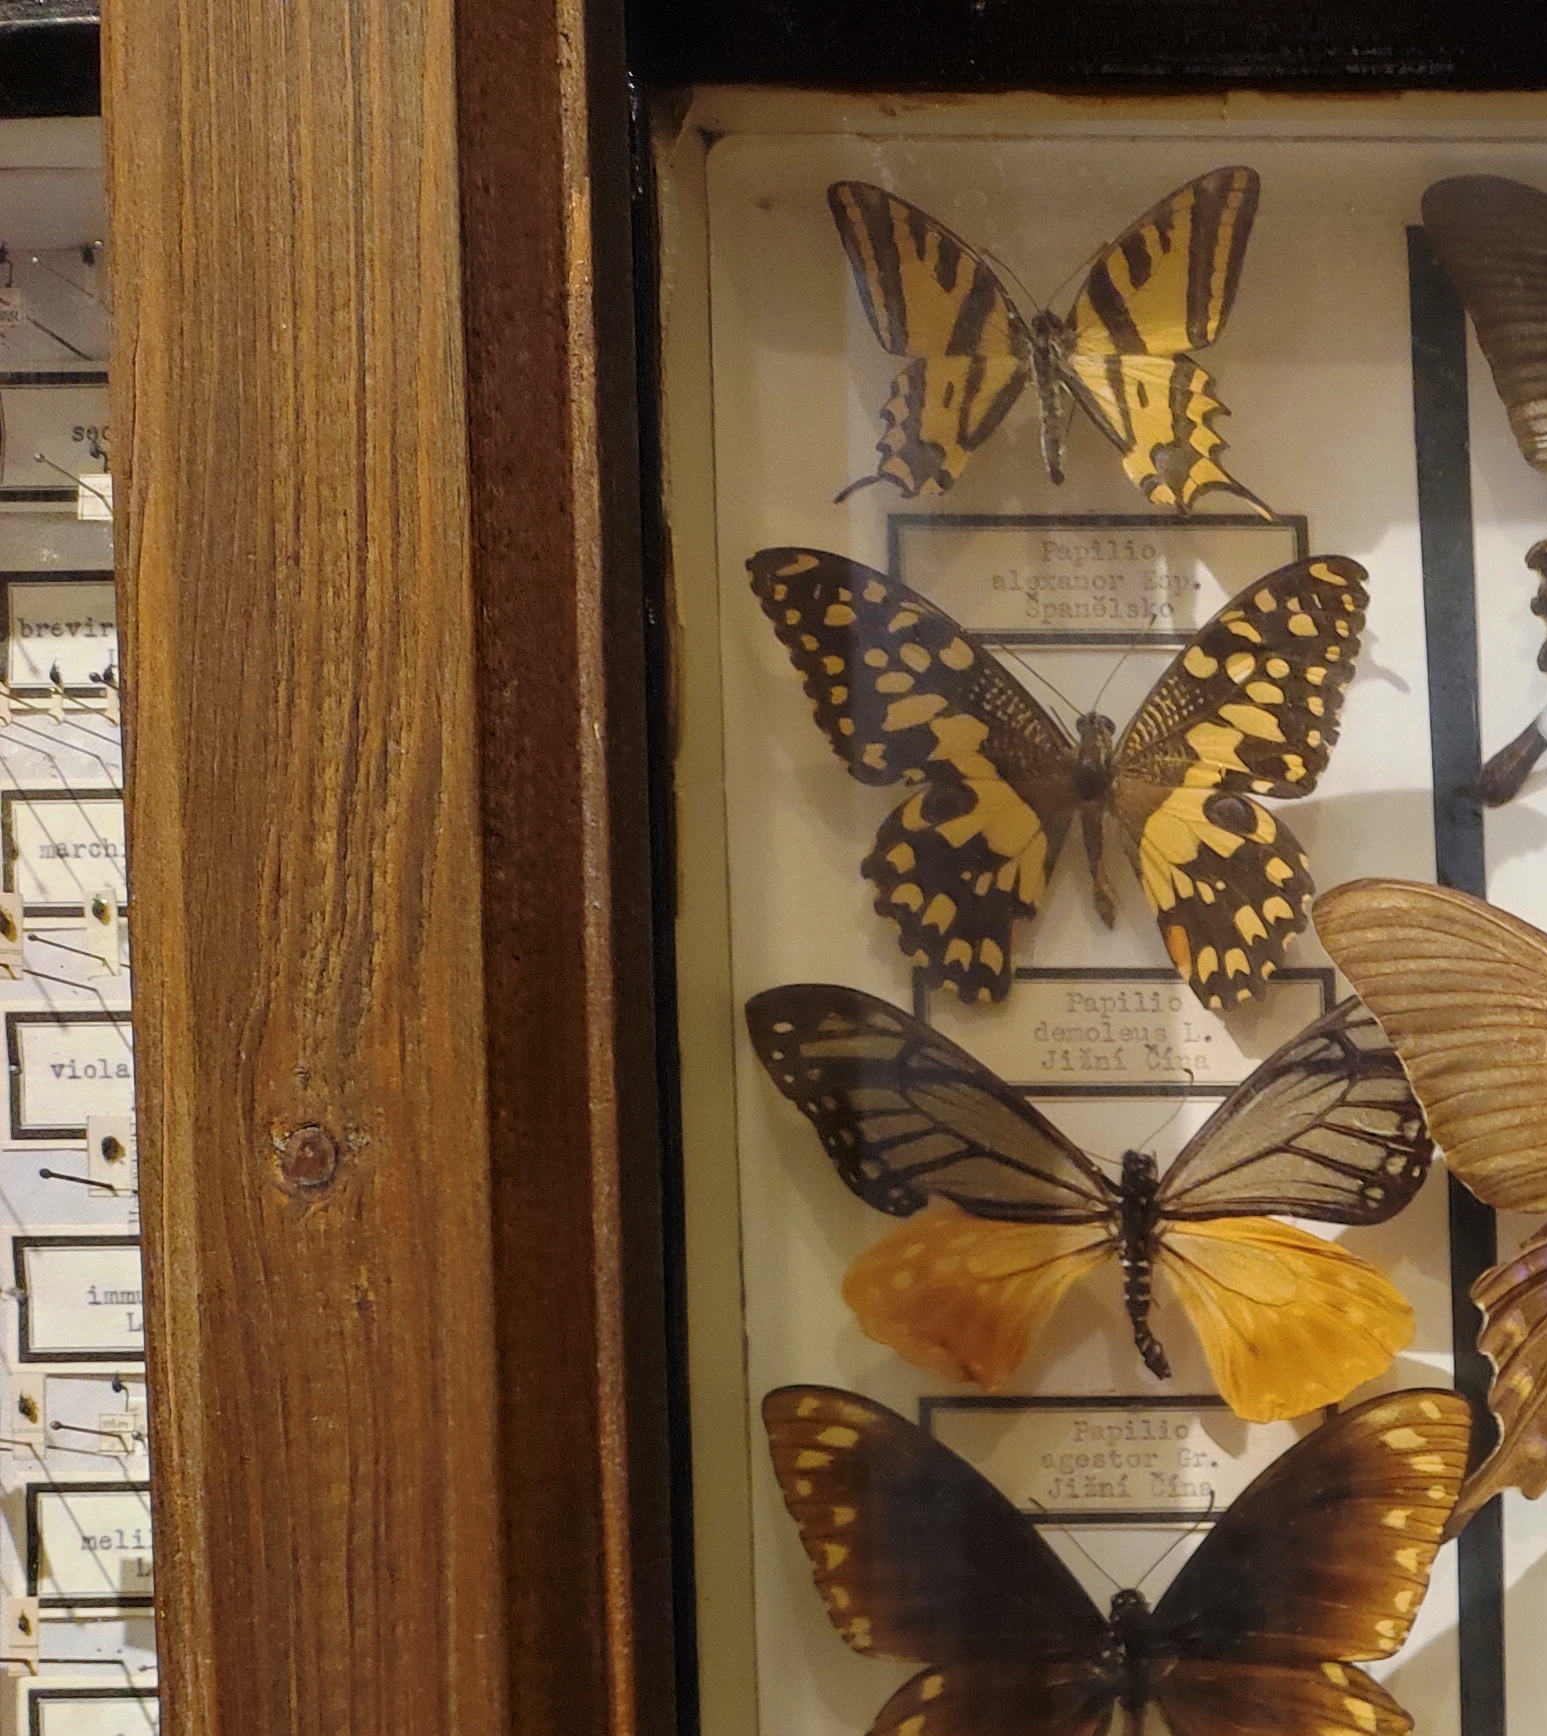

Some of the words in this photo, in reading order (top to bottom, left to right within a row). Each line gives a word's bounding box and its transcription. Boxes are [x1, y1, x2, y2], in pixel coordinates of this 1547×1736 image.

[1040, 539, 1158, 566] Papilio
[39, 839, 126, 859] march
[1064, 991, 1184, 1018] Papilio
[1034, 1020, 1168, 1045] demoleus
[1182, 1020, 1213, 1043] L.
[50, 1059, 132, 1080] viola
[1039, 1047, 1125, 1074] Jižní
[1144, 1041, 1211, 1072] Čína
[1072, 1419, 1190, 1447] Papilio
[1041, 1448, 1159, 1476] agestor
[1178, 1446, 1220, 1470] Gr.
[1046, 1473, 1134, 1501] Jižní
[1150, 1468, 1215, 1499] Čína
[81, 1529, 152, 1550] meli
